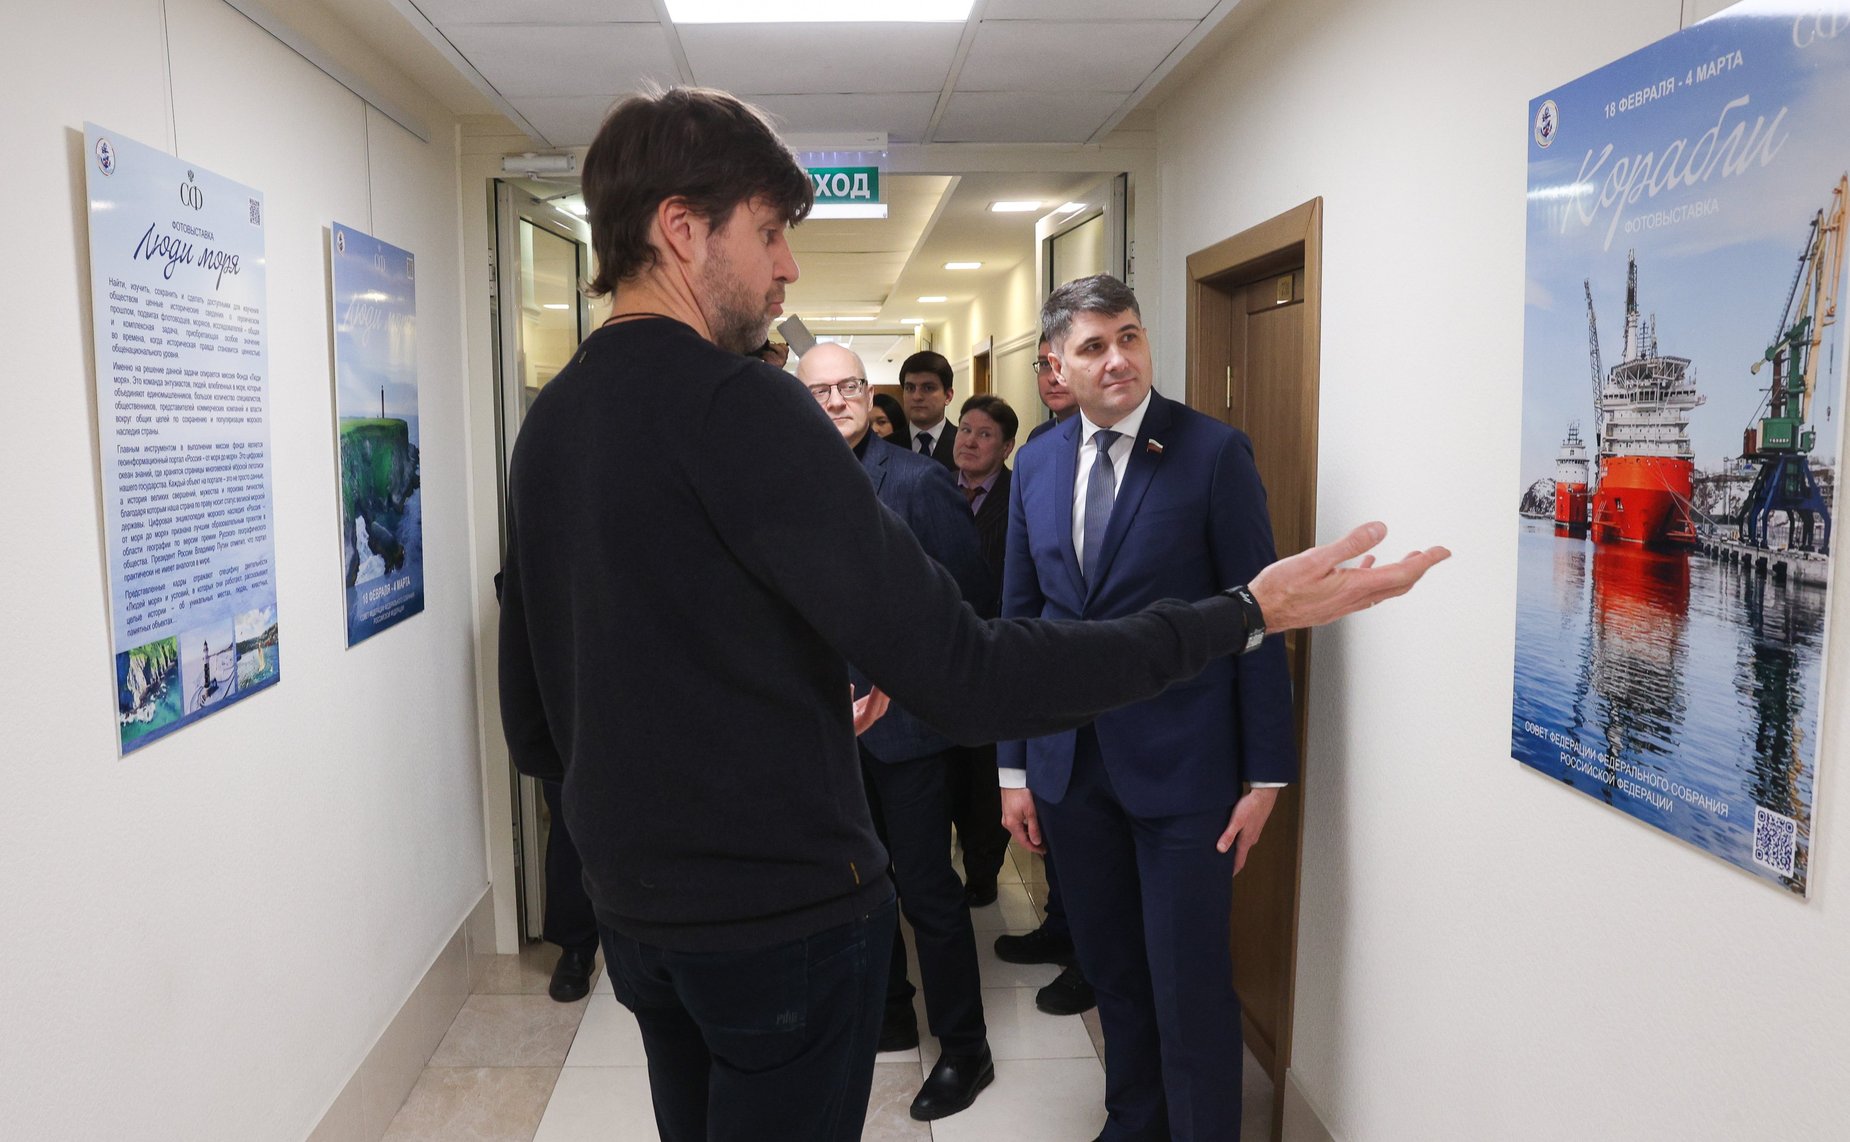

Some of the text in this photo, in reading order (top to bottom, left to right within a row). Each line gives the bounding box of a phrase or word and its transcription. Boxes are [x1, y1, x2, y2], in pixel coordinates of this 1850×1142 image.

[1604, 101, 1616, 119] 18
[1618, 77, 1675, 113] ФЕВРАЛЯ
[1685, 69, 1693, 86] 4
[1696, 49, 1744, 83] МАРТА
[180, 182, 203, 211] СФ
[809, 173, 871, 199] ХОД
[1561, 94, 1790, 251] Корабли
[172, 221, 215, 241] ФОТОВЫСТАВКА
[1624, 198, 1720, 234] ФОТОВЫСТАВКА
[133, 222, 241, 291] Люди моря
[1524, 720, 1729, 817] СОВЕТ ФЕДЕРАЦИИ ФЕДЕРАЛЬНОГО СОБРАНИЯ
[1560, 751, 1673, 813] РОССИЙСКОЙ ФЕДЕРАЦИИ
